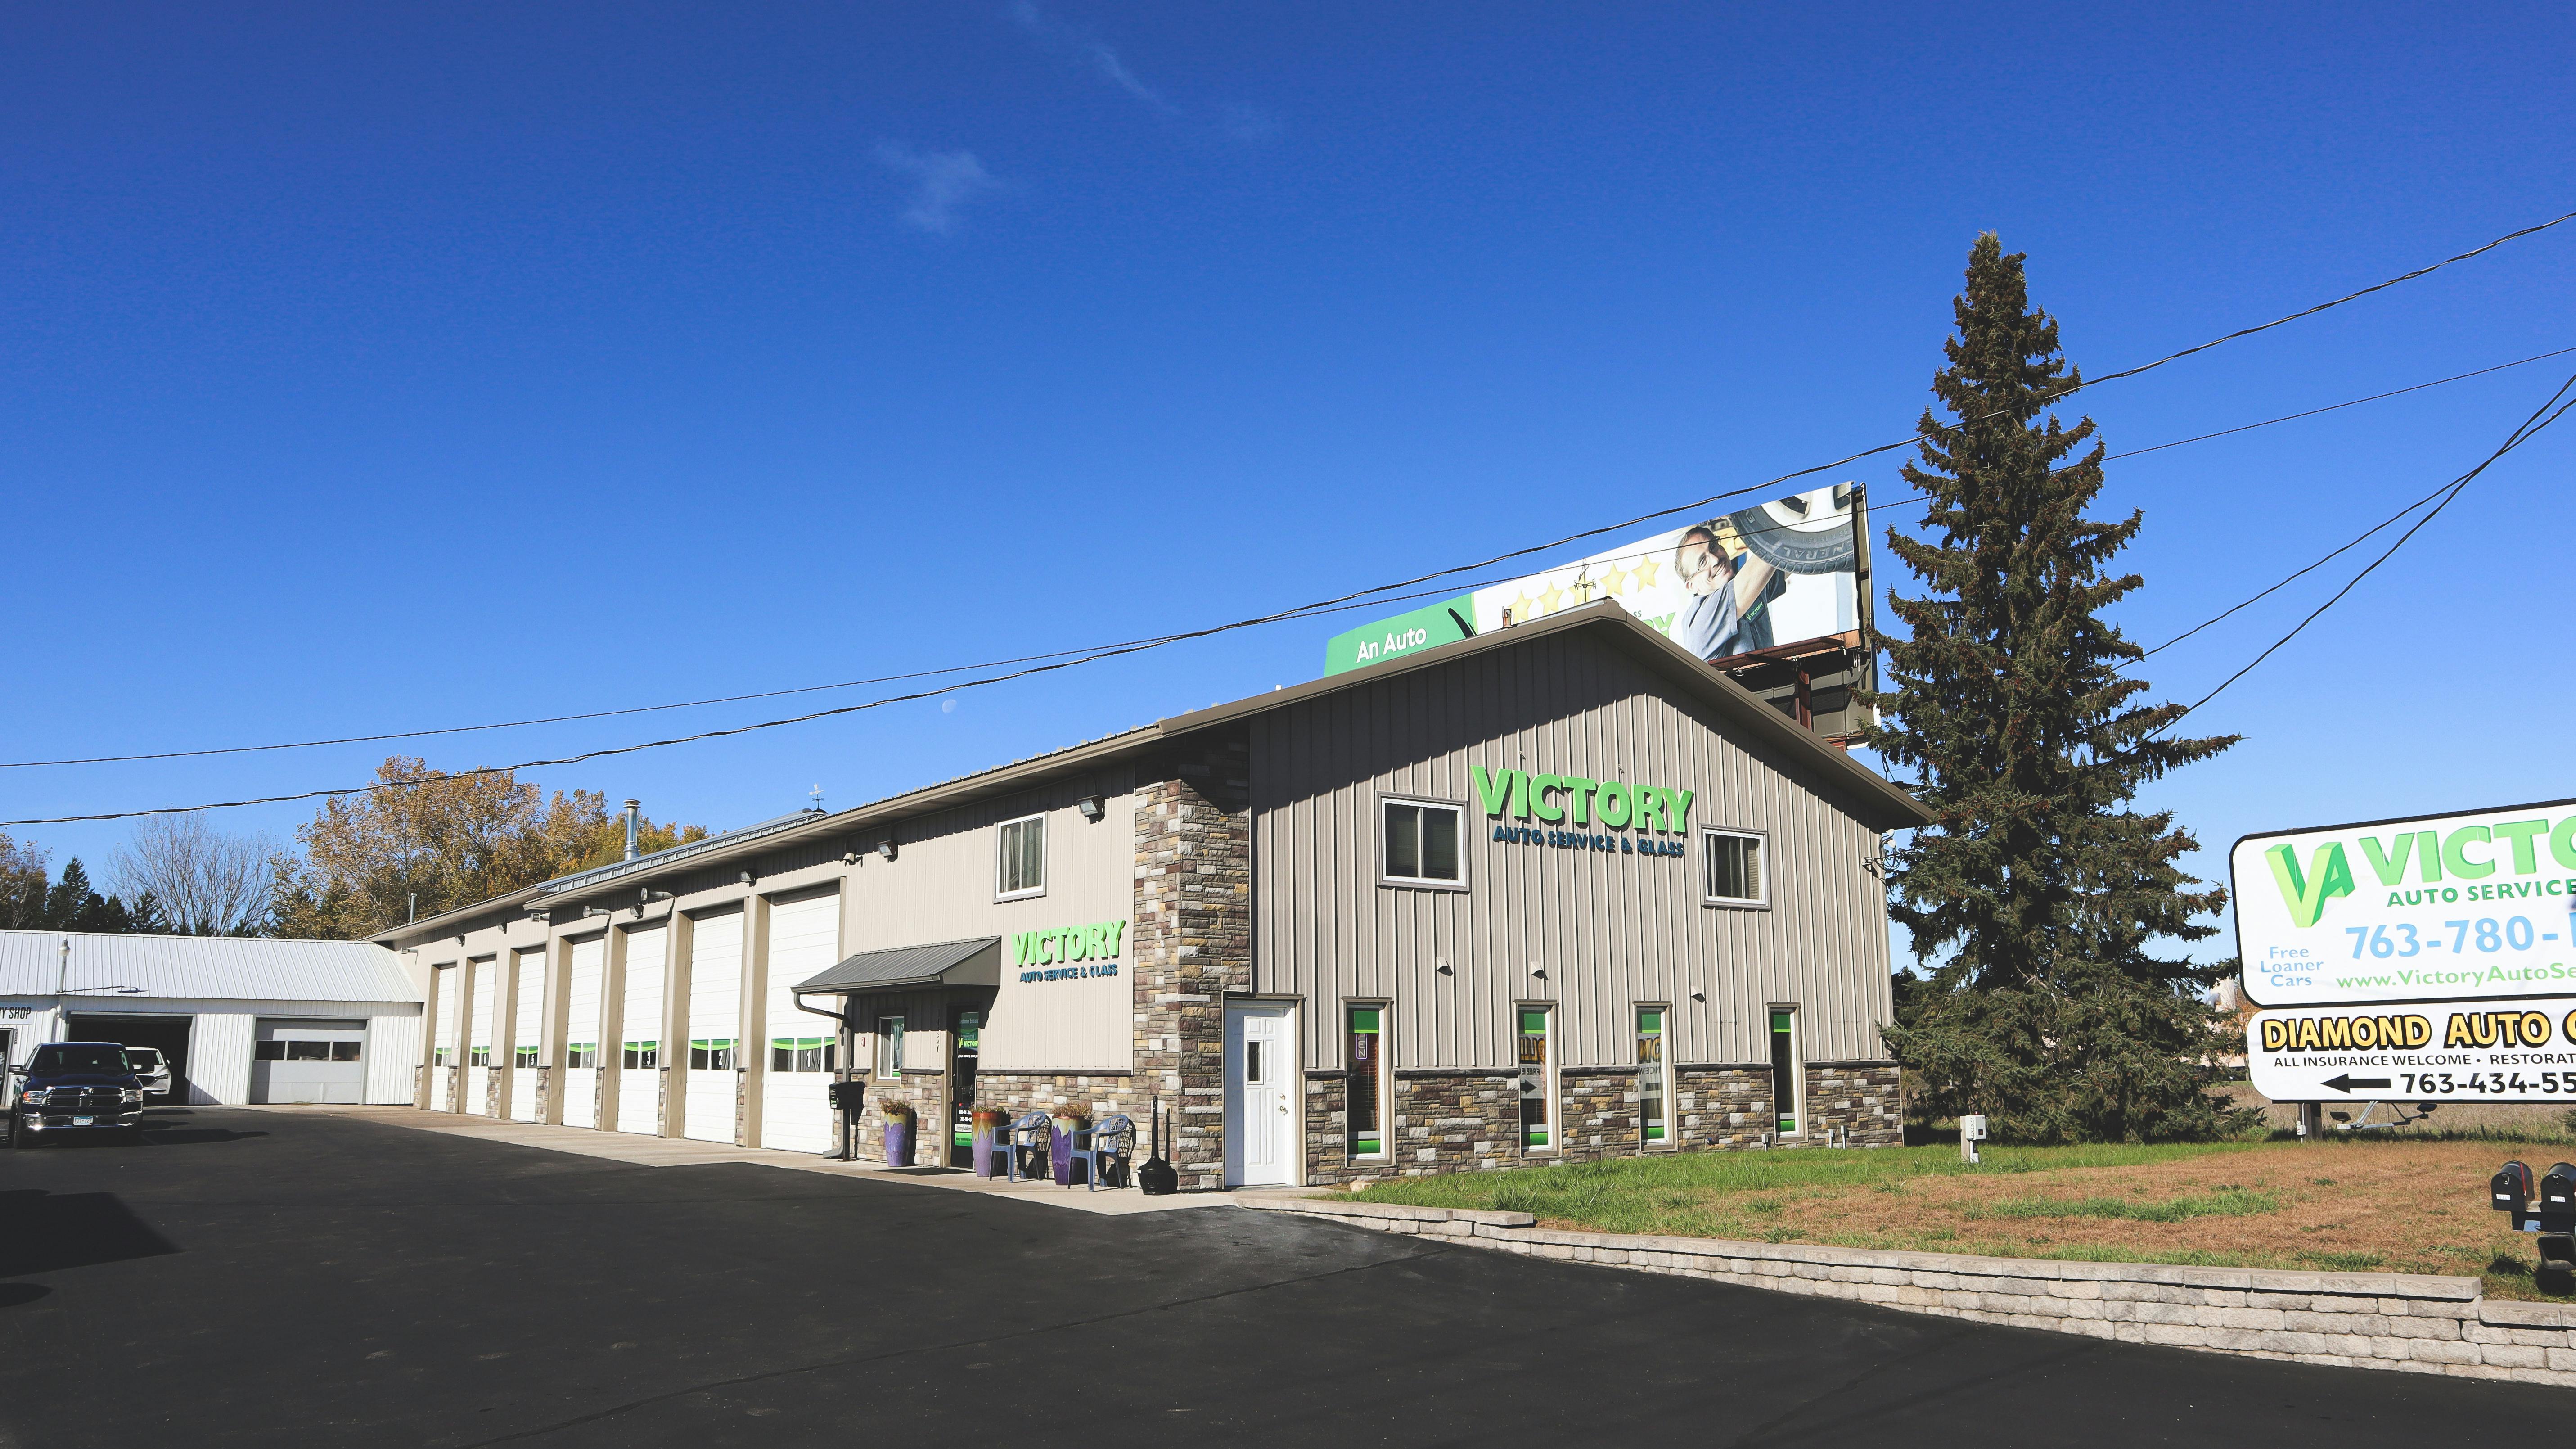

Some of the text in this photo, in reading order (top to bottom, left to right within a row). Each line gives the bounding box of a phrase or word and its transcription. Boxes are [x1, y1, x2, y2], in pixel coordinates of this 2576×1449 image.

[1356, 628, 1427, 663] An Auto
[1470, 765, 1693, 833] VICTORY
[1492, 826, 1684, 856] AUTO SERVICE & GLASS
[2387, 879, 2576, 907] AUTO SERVICE
[1011, 920, 1126, 966] VICTORY
[2270, 946, 2310, 959] Free
[1020, 964, 1118, 983] AUTO SERVICE & GLASS
[2261, 961, 2324, 973] Loaner
[2270, 974, 2312, 987] Cars
[9, 1007, 32, 1019] SHOP
[2261, 1014, 2432, 1052] DIAMOND
[2443, 1010, 2552, 1049] AUTO
[647, 1051, 651, 1065] 3
[718, 1050, 723, 1066] 2
[807, 1050, 811, 1068] 1
[2274, 1053, 2576, 1067] ALL INSURANCE WELCOME RESTORAT
[2400, 1072, 2576, 1094] 763-434-55
